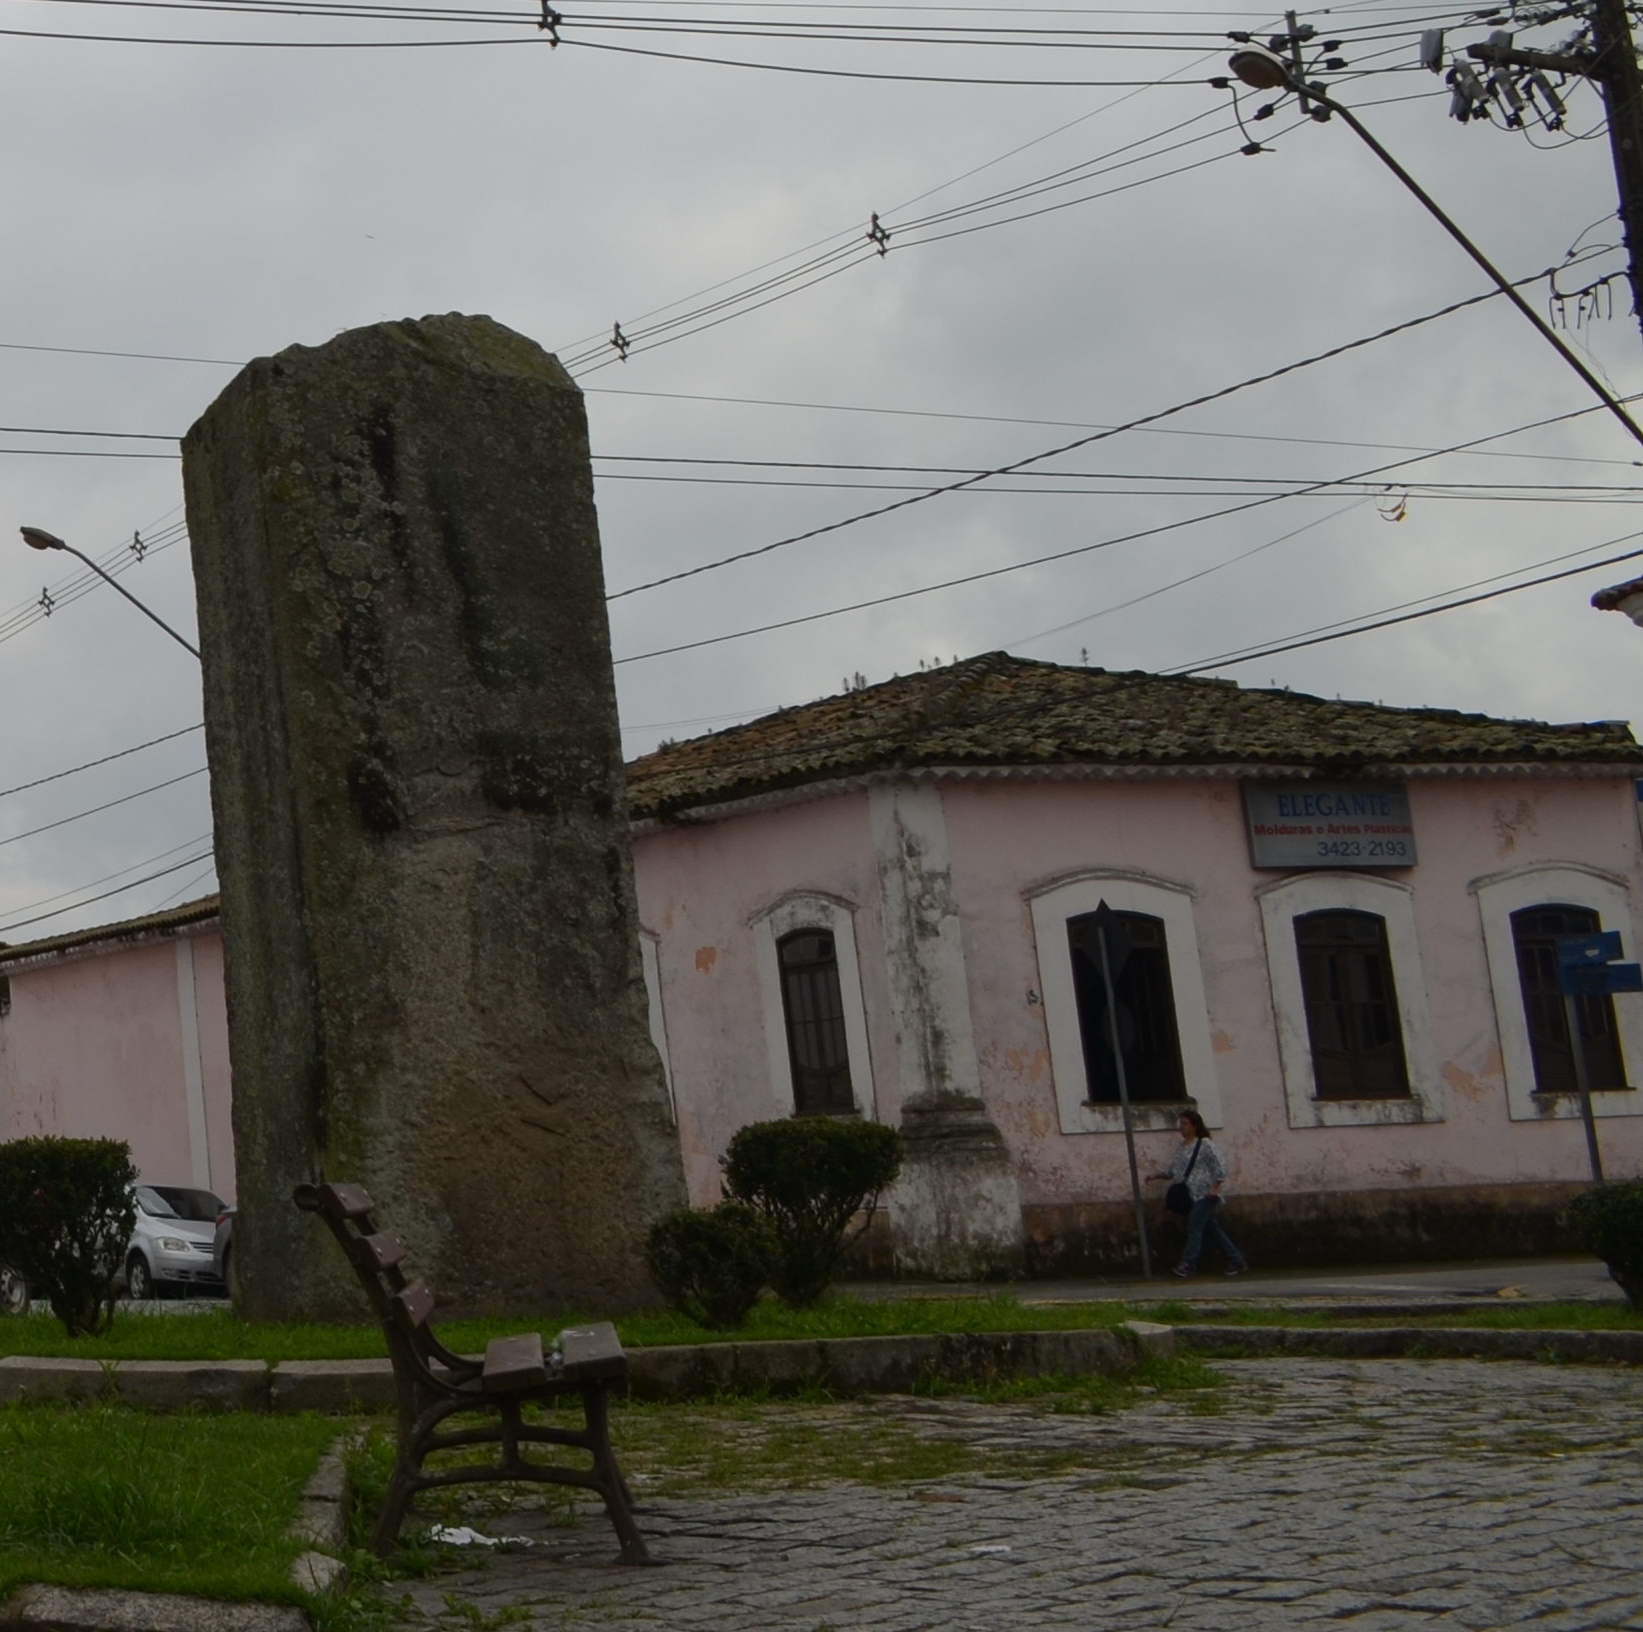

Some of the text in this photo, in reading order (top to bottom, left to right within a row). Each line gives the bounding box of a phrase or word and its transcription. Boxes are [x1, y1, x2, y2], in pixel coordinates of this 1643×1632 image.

[1276, 793, 1391, 817] ELEGANTE
[1253, 823, 1314, 836] Molduras
[1316, 826, 1324, 835] e
[1327, 823, 1361, 835] Artes
[1317, 840, 1407, 857] 3423-2193
